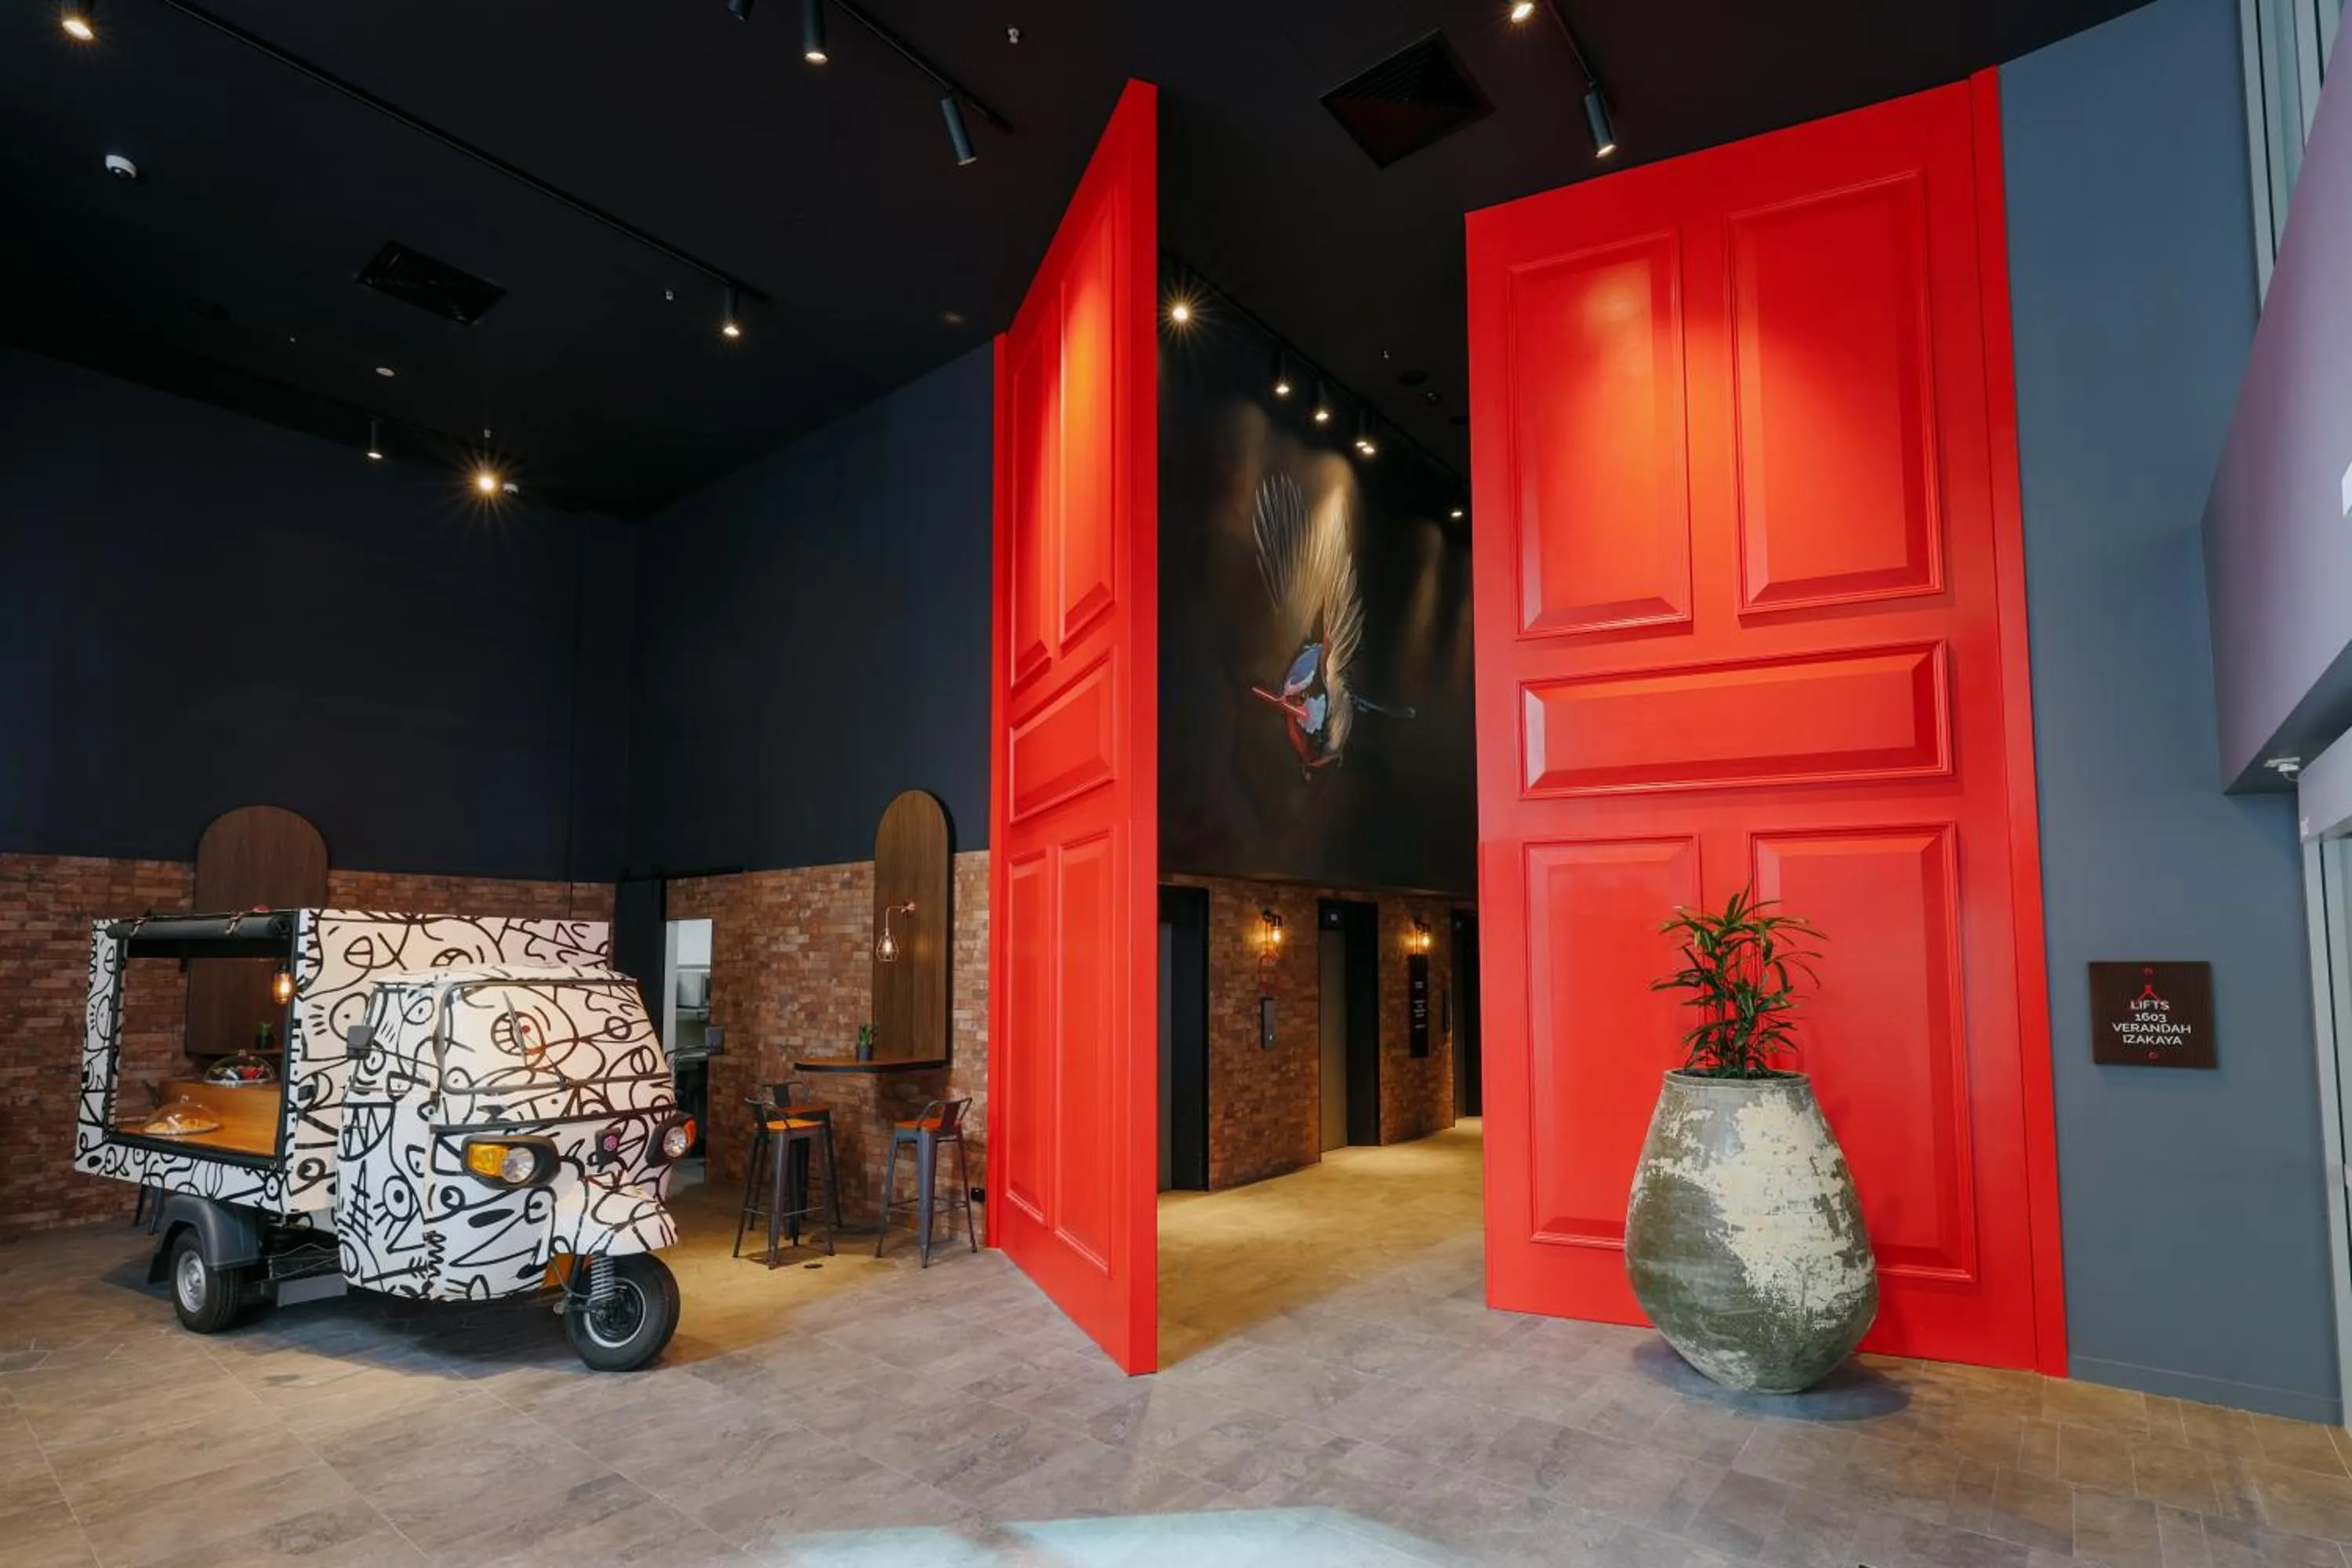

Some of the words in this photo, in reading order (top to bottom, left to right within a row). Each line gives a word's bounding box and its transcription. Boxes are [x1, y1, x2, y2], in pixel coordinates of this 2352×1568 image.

[2130, 1000, 2170, 1011] LIFTS
[2135, 1012, 2166, 1023] 1603
[2112, 1022, 2191, 1034] VERANDAH
[2122, 1034, 2183, 1045] IZAKAYA
